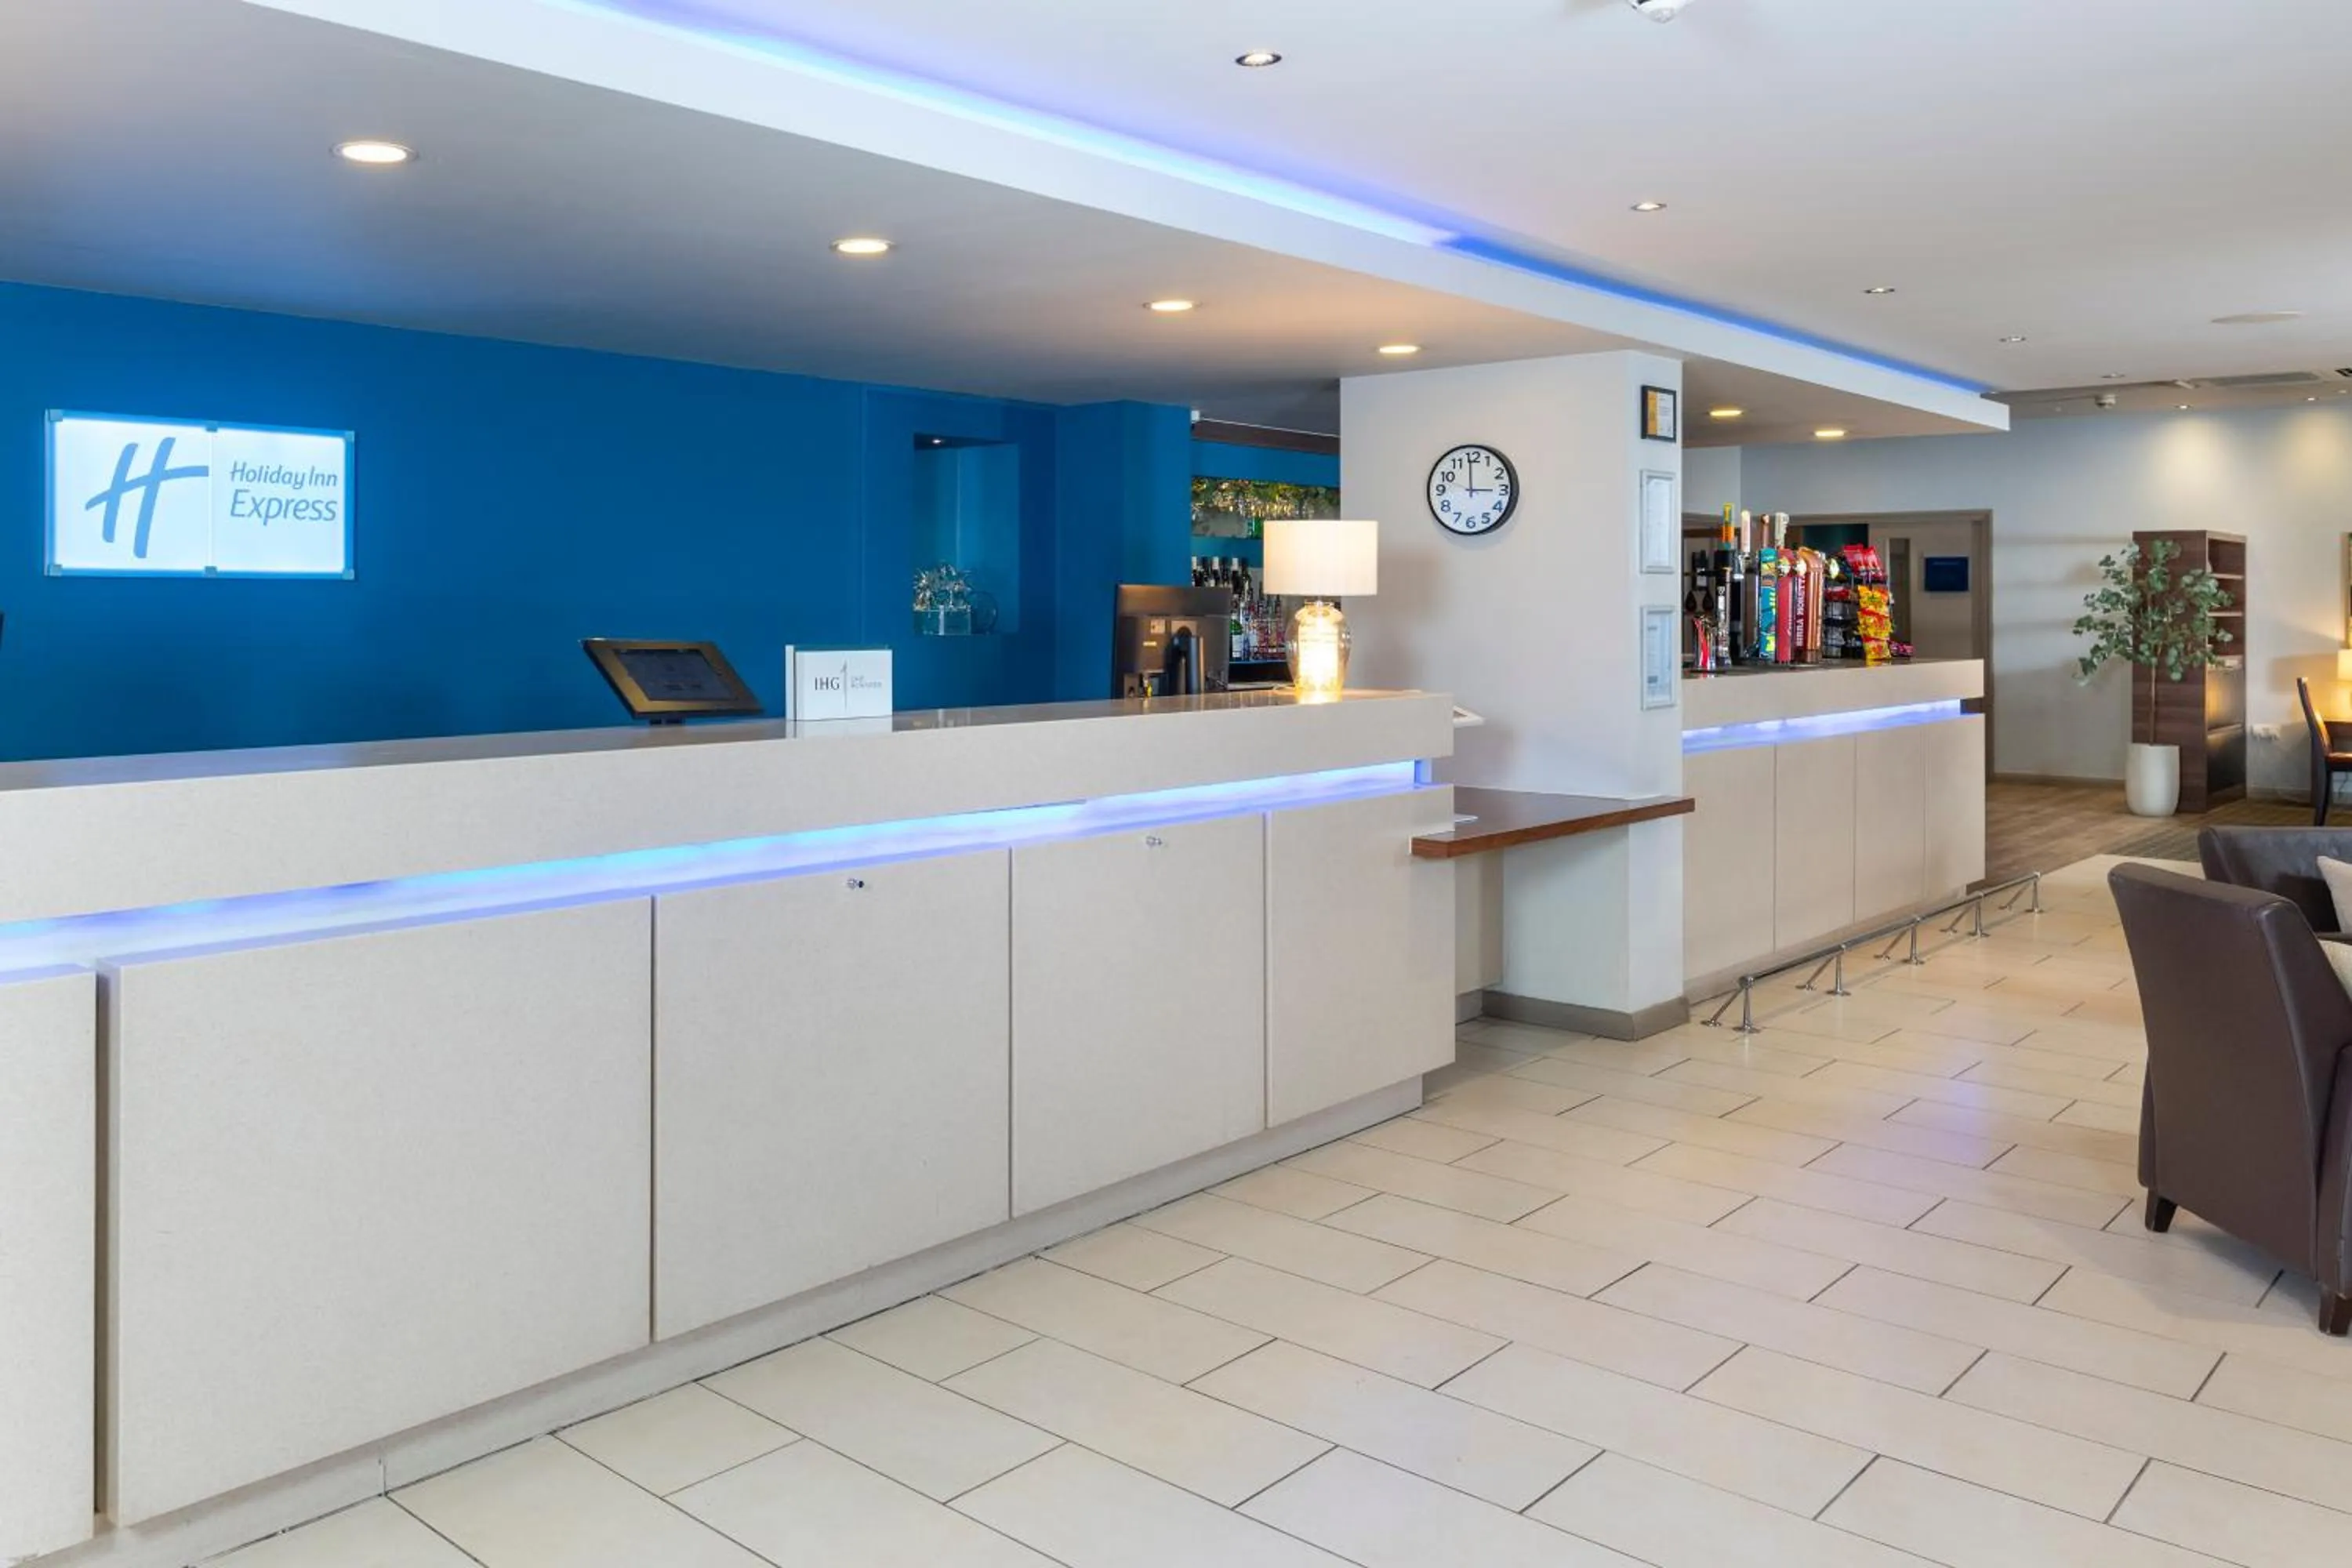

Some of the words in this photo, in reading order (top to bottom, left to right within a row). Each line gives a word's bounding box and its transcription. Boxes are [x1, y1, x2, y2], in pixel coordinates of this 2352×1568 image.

[1465, 451, 1481, 463] 12
[1484, 456, 1490, 467] 1
[1451, 458, 1463, 470] 11
[230, 461, 305, 489] Holiday
[308, 466, 338, 487] Inn
[1441, 470, 1456, 483] 10
[1494, 466, 1504, 480] 2
[1436, 484, 1446, 496] 9
[1498, 484, 1509, 496] 3
[230, 488, 339, 525] Express
[1440, 499, 1451, 513] 8
[1492, 500, 1503, 513] 4
[1453, 512, 1462, 524] 7
[1465, 516, 1476, 529] 6
[1481, 512, 1491, 524] 5
[815, 677, 840, 691] IHG
